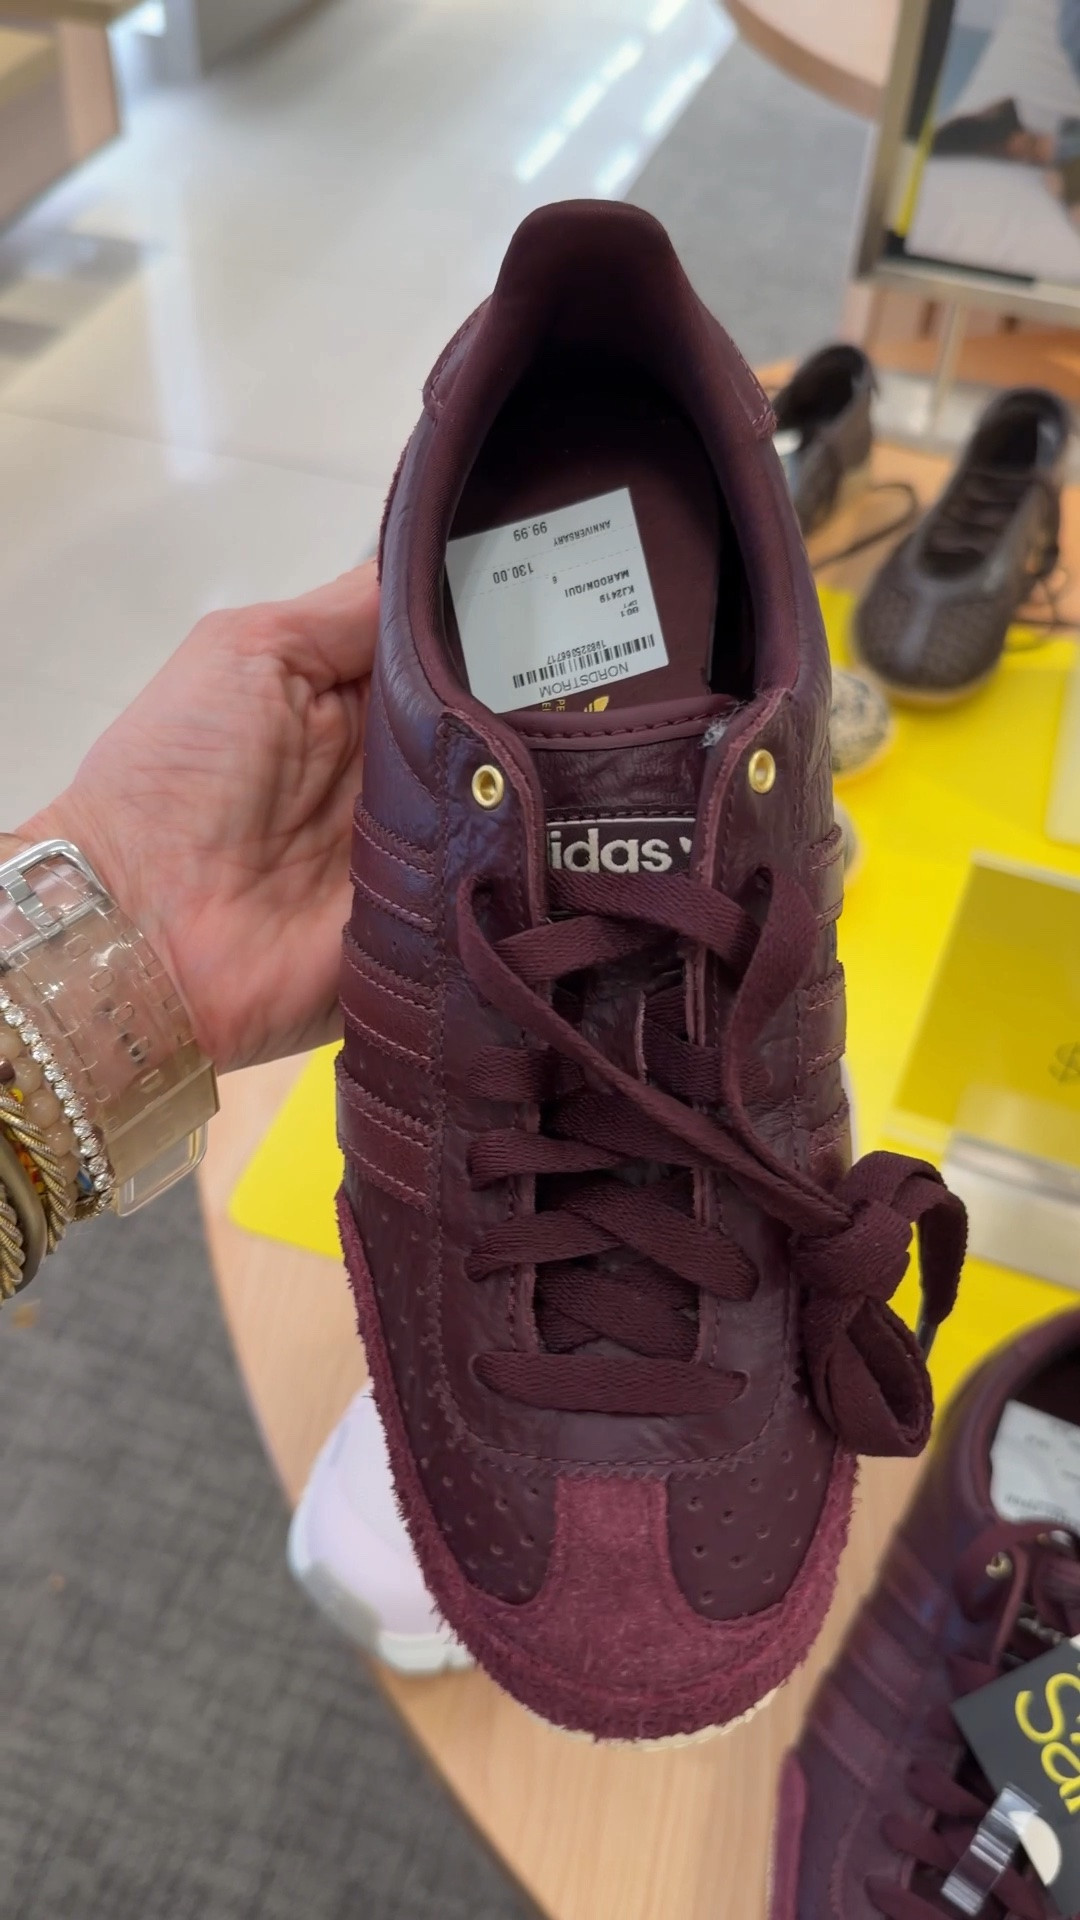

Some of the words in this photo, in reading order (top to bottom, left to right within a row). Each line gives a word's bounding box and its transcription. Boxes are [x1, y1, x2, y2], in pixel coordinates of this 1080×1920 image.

[513, 521, 548, 541] 99.99
[553, 520, 611, 547] ANNIVERSARY
[492, 562, 534, 584] 130.00
[599, 585, 635, 604] KJ2419
[539, 662, 629, 698] NORDSTROM
